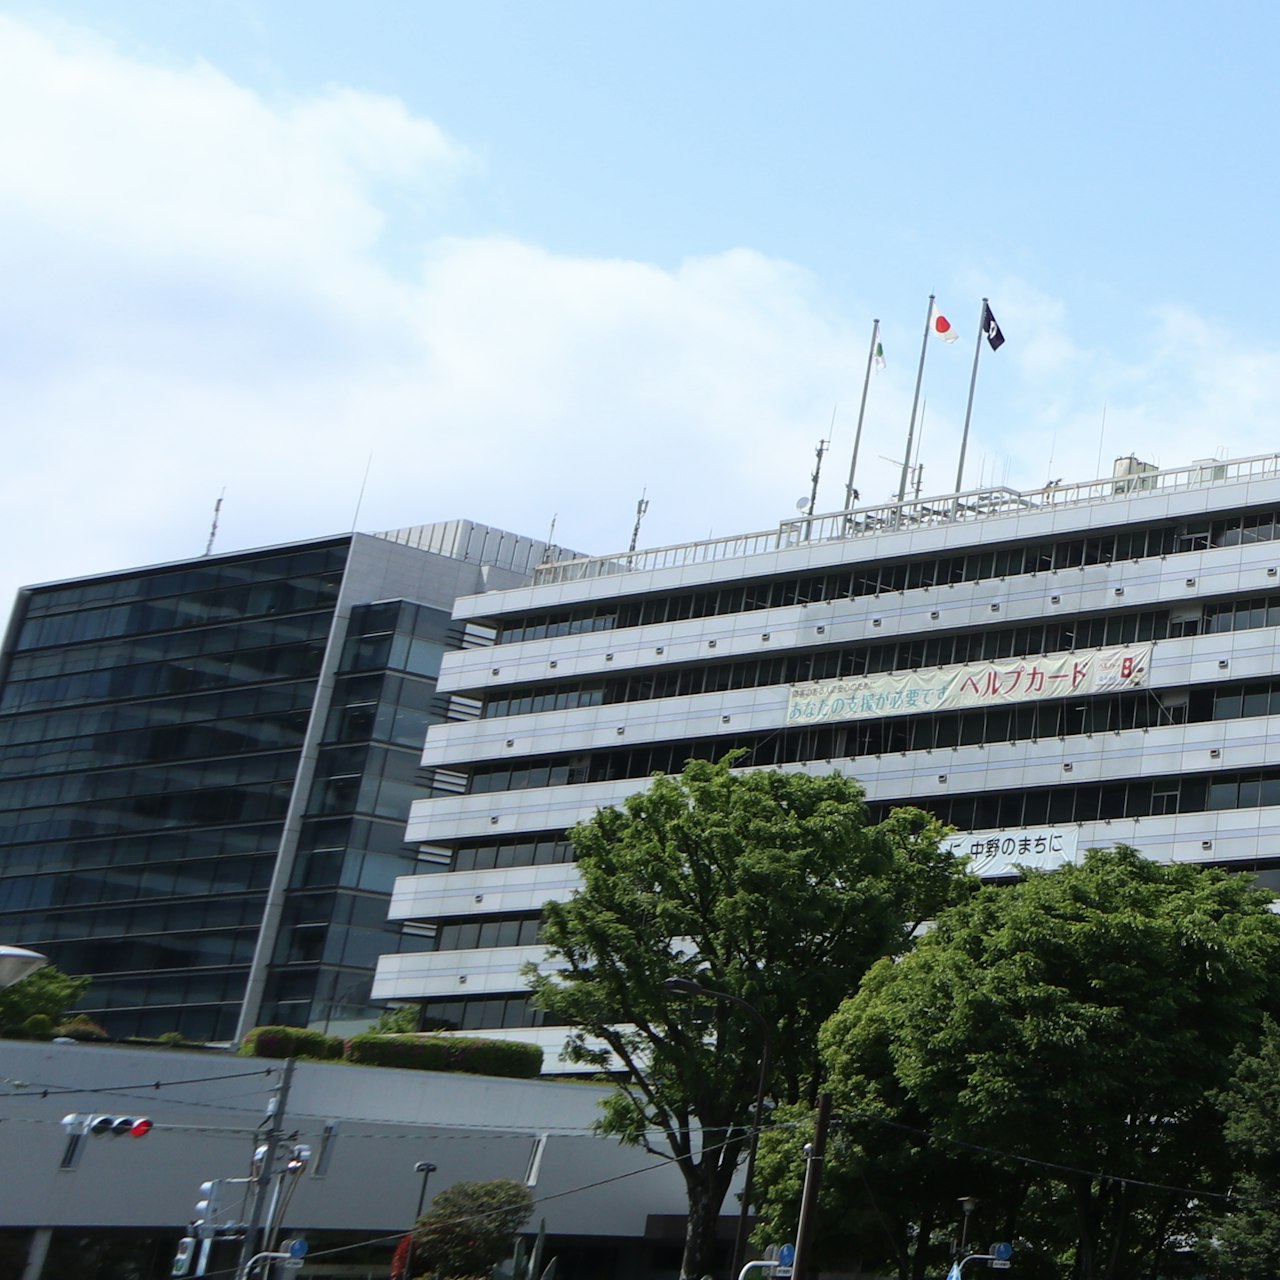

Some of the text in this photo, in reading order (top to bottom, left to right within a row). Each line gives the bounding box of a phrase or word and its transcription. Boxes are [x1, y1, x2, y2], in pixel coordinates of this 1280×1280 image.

[959, 662, 1089, 698] ヘルプカード
[790, 685, 949, 720] あなたの支援が必要です
[970, 834, 1063, 859] 中野のまちに
